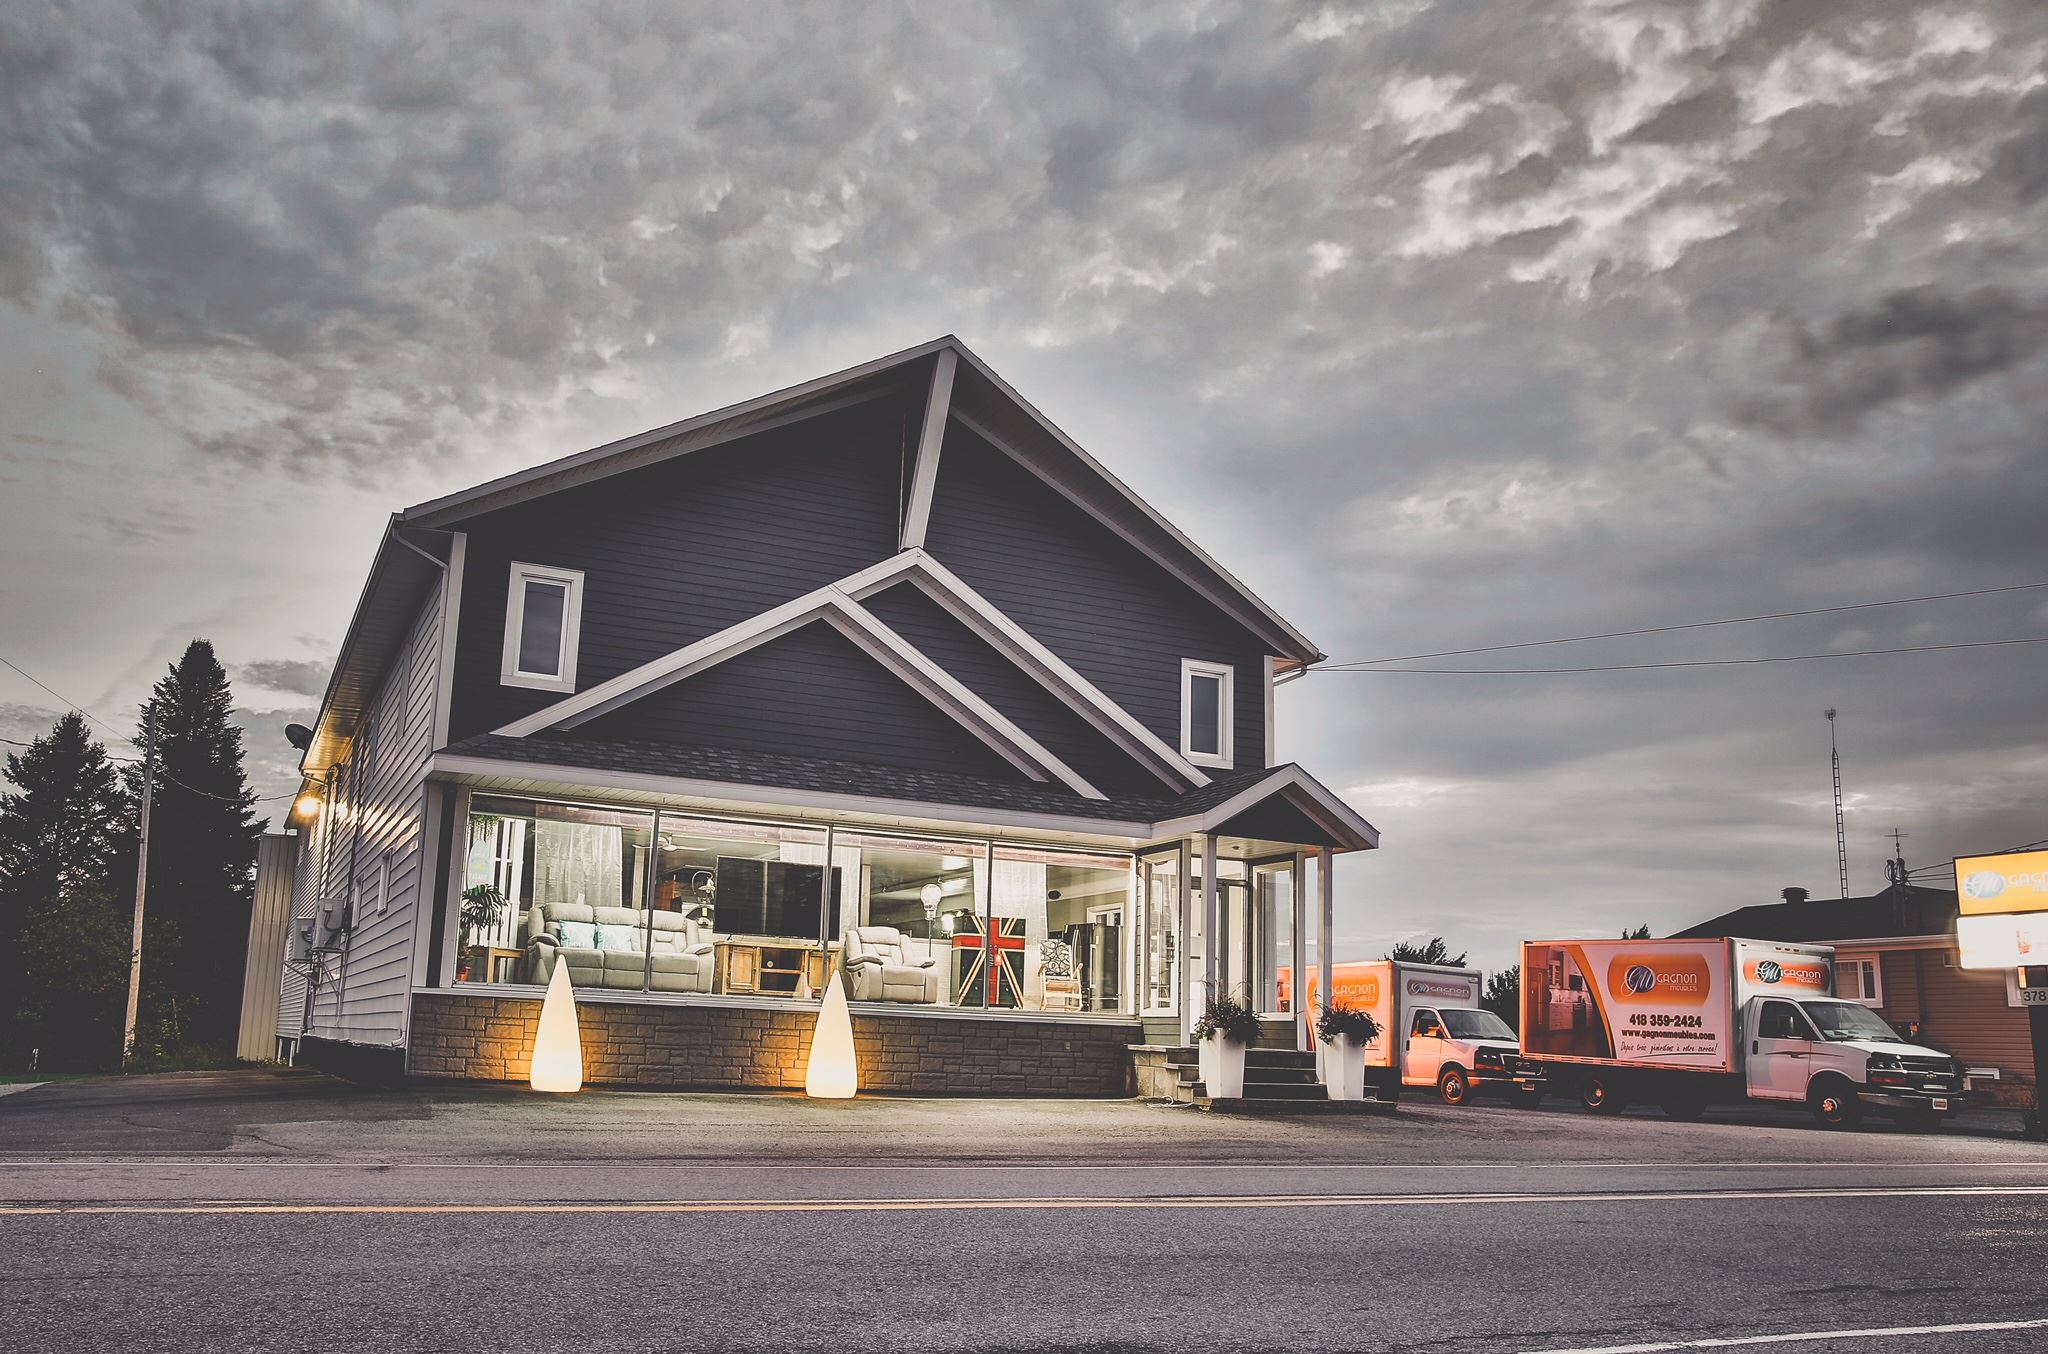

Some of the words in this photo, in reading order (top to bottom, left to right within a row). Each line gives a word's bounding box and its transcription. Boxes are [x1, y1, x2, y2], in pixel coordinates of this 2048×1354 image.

[1656, 973, 1697, 984] GAGNON
[1334, 983, 1376, 995] GAGNON
[2023, 990, 2047, 1002] 378
[1629, 1014, 1647, 1026] 418
[1649, 1014, 1702, 1028] 359-2424
[1621, 1029, 1715, 1041] www.gagnonmeubles.com
